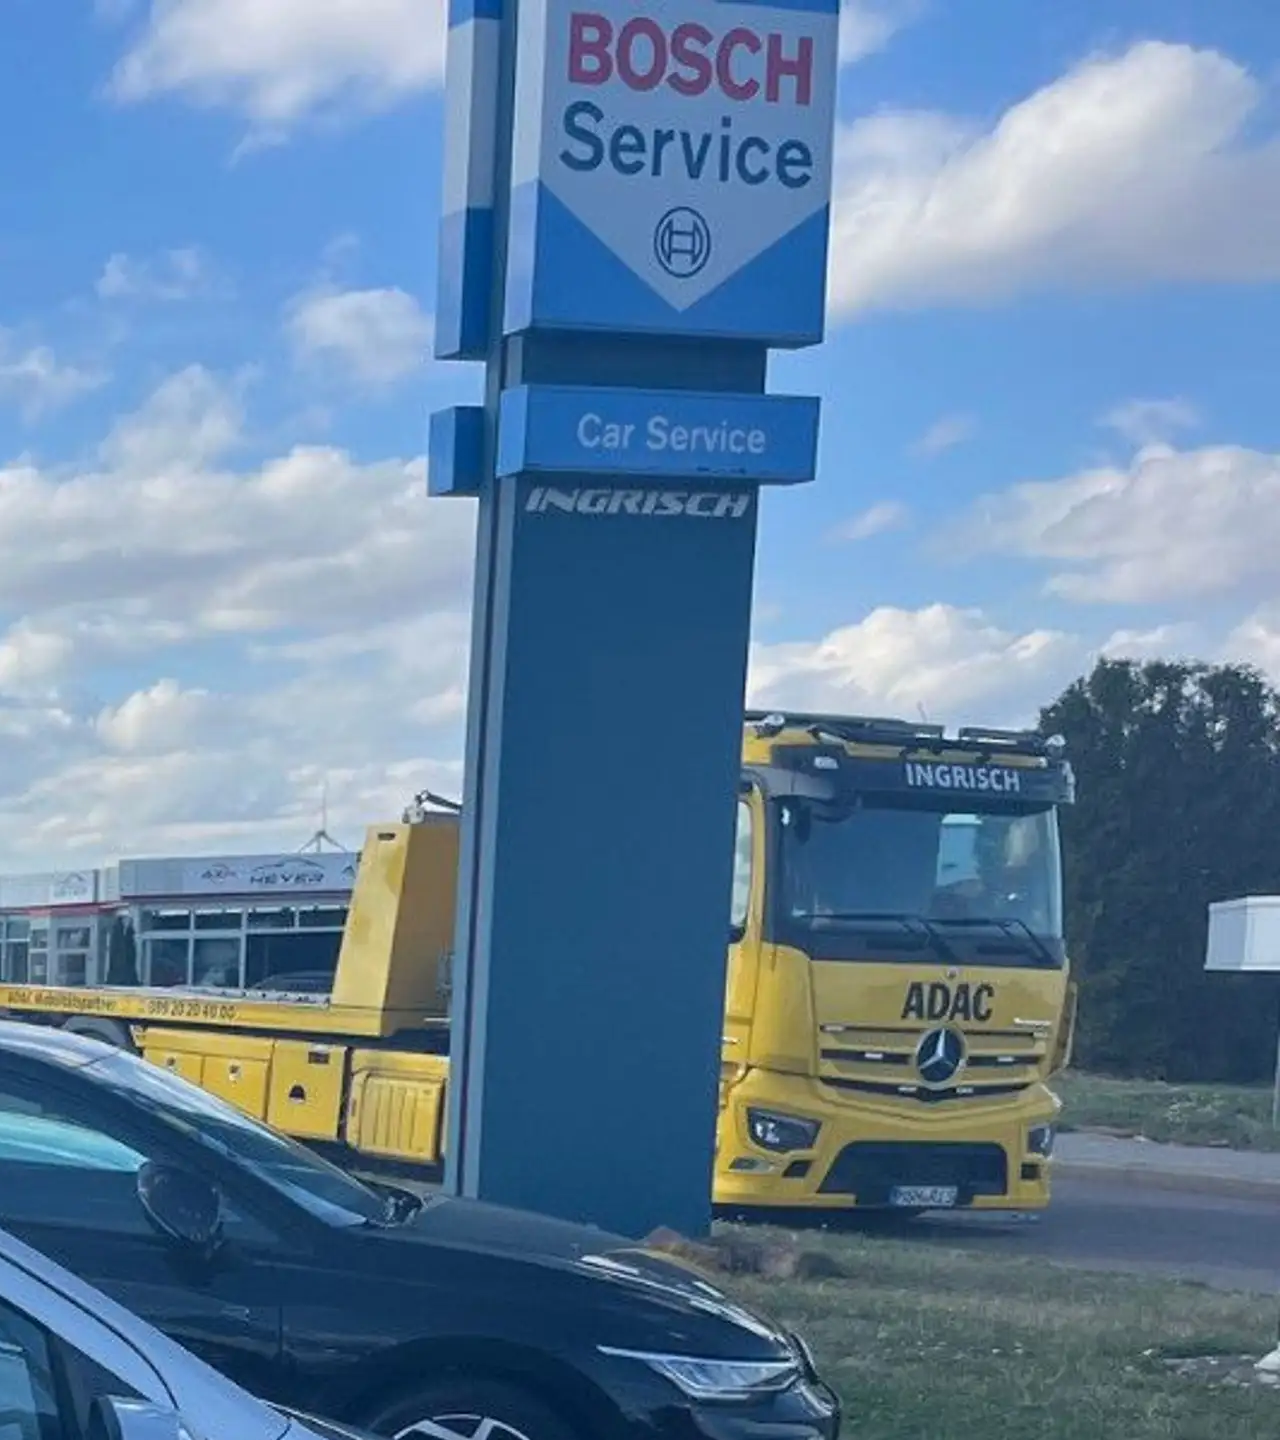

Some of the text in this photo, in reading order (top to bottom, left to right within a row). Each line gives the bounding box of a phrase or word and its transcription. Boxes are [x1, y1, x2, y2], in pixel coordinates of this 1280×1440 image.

[568, 12, 813, 105] BOSCH
[559, 101, 813, 189] Service
[577, 413, 766, 454] Car Service
[525, 486, 750, 518] INGRISCH
[905, 762, 1020, 792] INGRISCH
[900, 982, 995, 1021] ADAC
